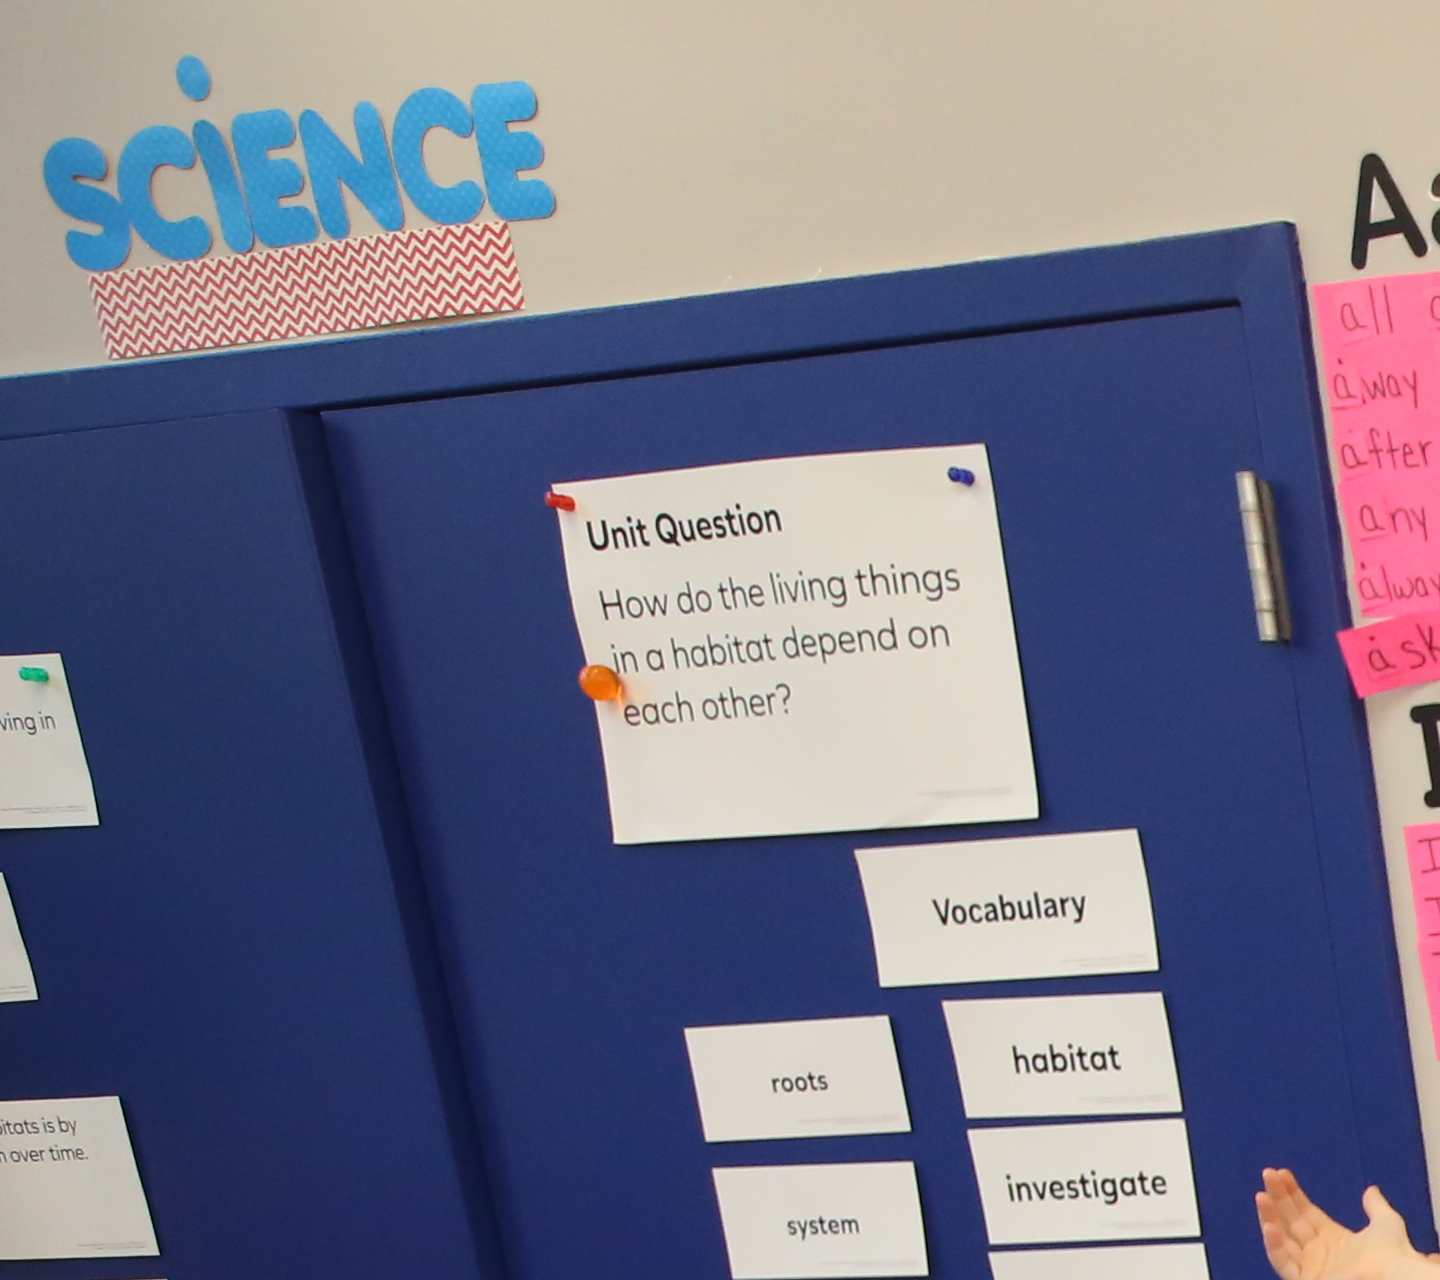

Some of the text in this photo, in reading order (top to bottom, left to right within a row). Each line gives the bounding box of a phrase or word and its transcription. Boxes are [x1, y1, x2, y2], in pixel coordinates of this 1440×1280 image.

[1332, 369, 1418, 408] away
[1341, 427, 1433, 471] after
[585, 503, 782, 553] Unit Question
[600, 563, 960, 621] How do the living things
[610, 617, 951, 674] in a habitat depend on
[39, 711, 56, 731] in
[623, 683, 792, 727] each other?
[932, 891, 1087, 927] Vocabulary
[1012, 1044, 1122, 1075] habitat
[771, 1072, 828, 1094] roots
[42, 1117, 76, 1136] is by
[12, 1146, 88, 1162] over time.
[1005, 1170, 1168, 1205] investigate
[786, 1215, 860, 1242] system
